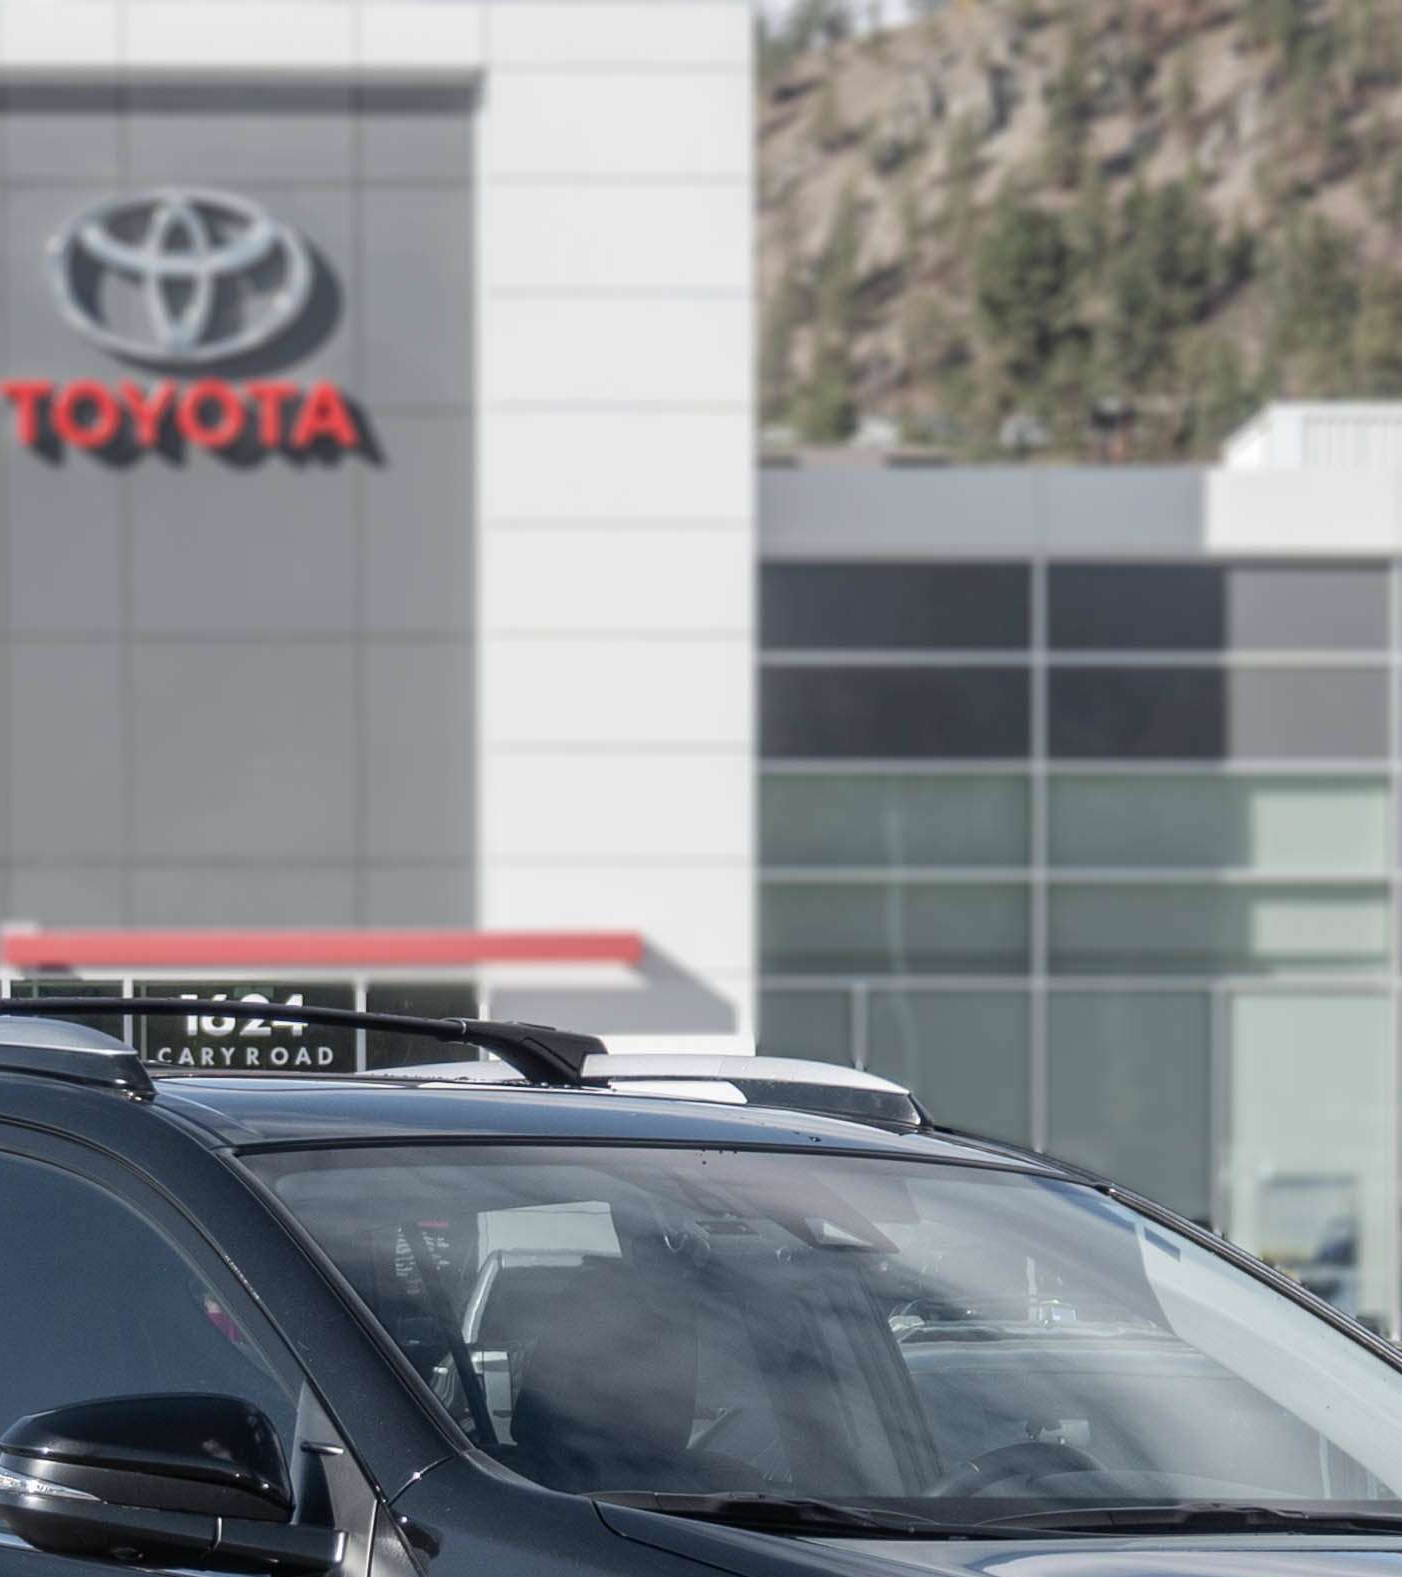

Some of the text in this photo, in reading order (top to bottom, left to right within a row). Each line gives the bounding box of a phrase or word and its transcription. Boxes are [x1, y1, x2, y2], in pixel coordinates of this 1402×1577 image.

[0, 379, 359, 448] TOYOTA
[180, 993, 309, 1036] 1624
[157, 1046, 334, 1066] CARY ROAD
